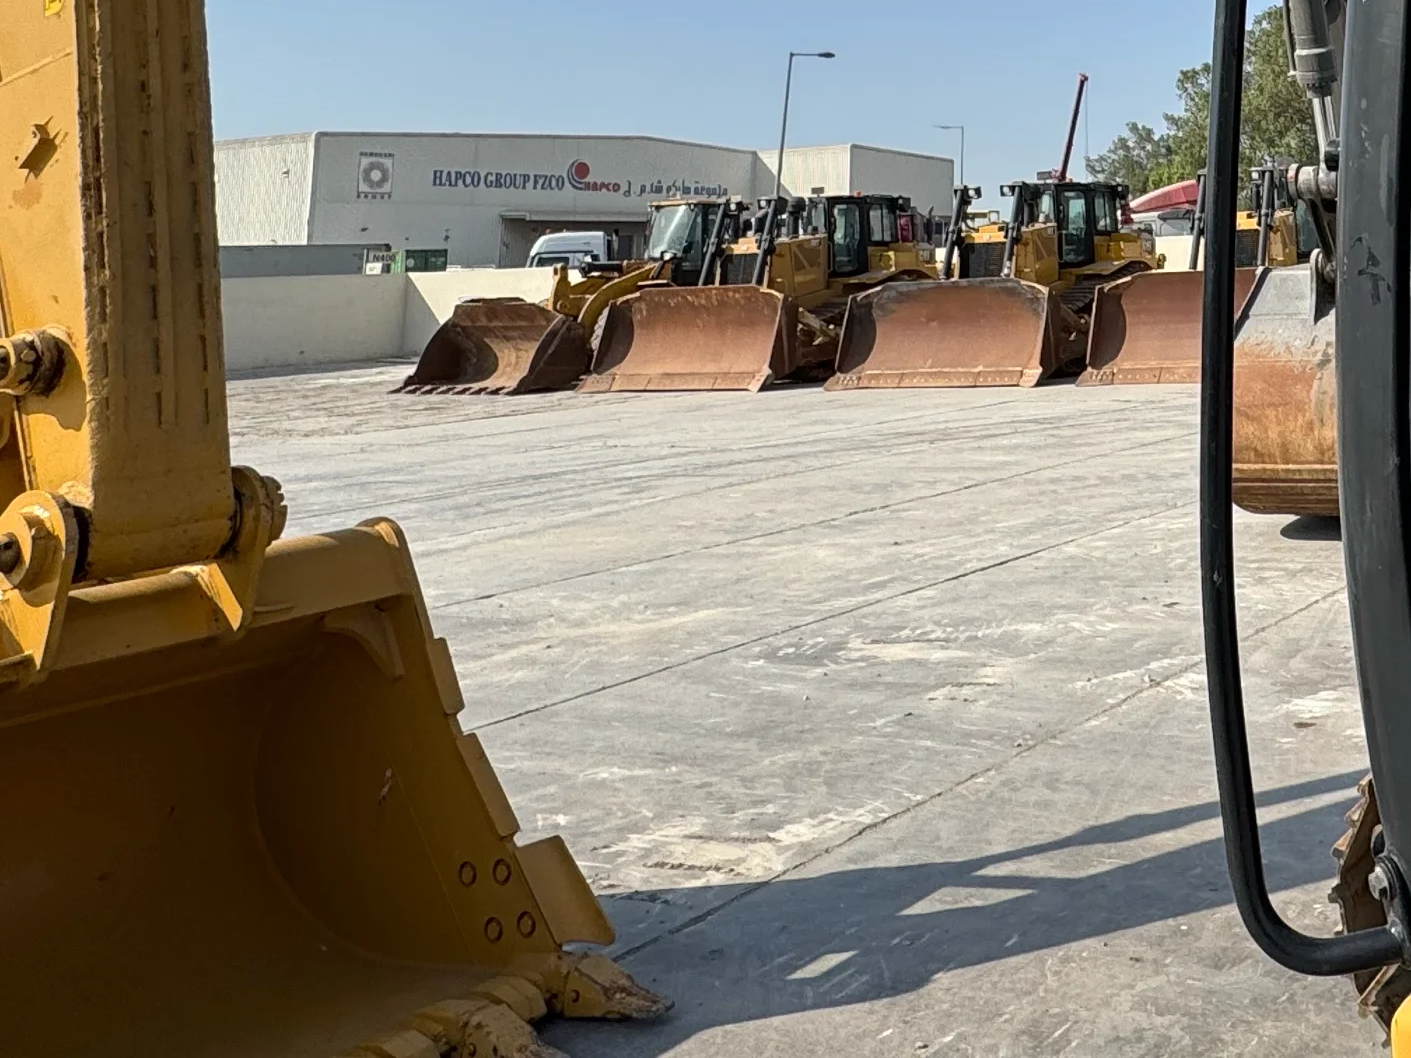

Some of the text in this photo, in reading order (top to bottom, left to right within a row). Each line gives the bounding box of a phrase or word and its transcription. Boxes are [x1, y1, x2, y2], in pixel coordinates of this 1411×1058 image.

[432, 169, 565, 191] HAPCO GROUP FZCO
